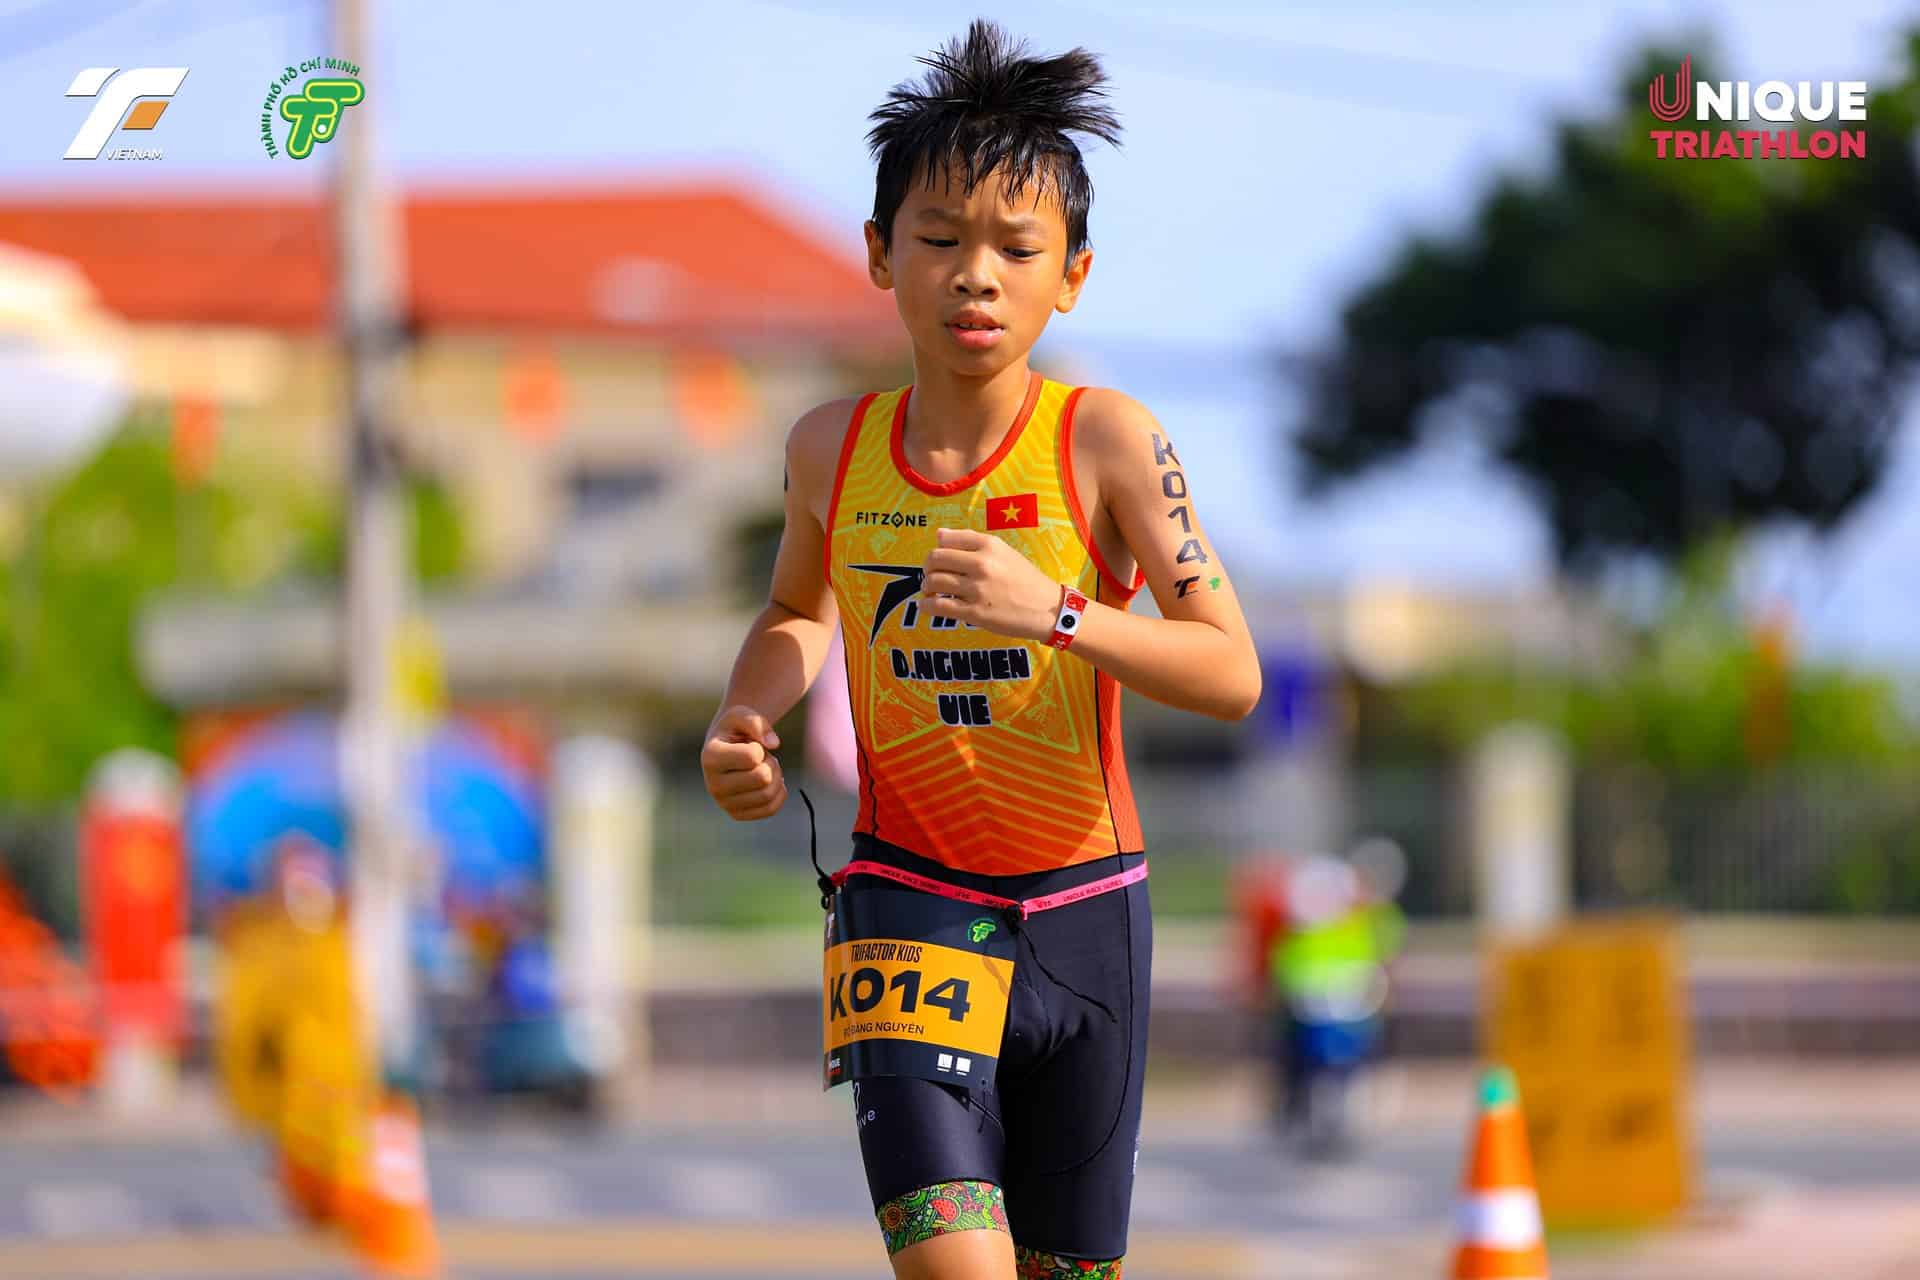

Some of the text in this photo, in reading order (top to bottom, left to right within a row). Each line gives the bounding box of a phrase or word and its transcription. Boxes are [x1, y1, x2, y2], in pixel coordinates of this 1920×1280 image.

[855, 511, 928, 528] FITZONE
[890, 647, 1032, 682] D.NGUYEN
[851, 943, 922, 963] TRIFACTOR KIDS
[875, 1022, 925, 1035] NGUYEN
